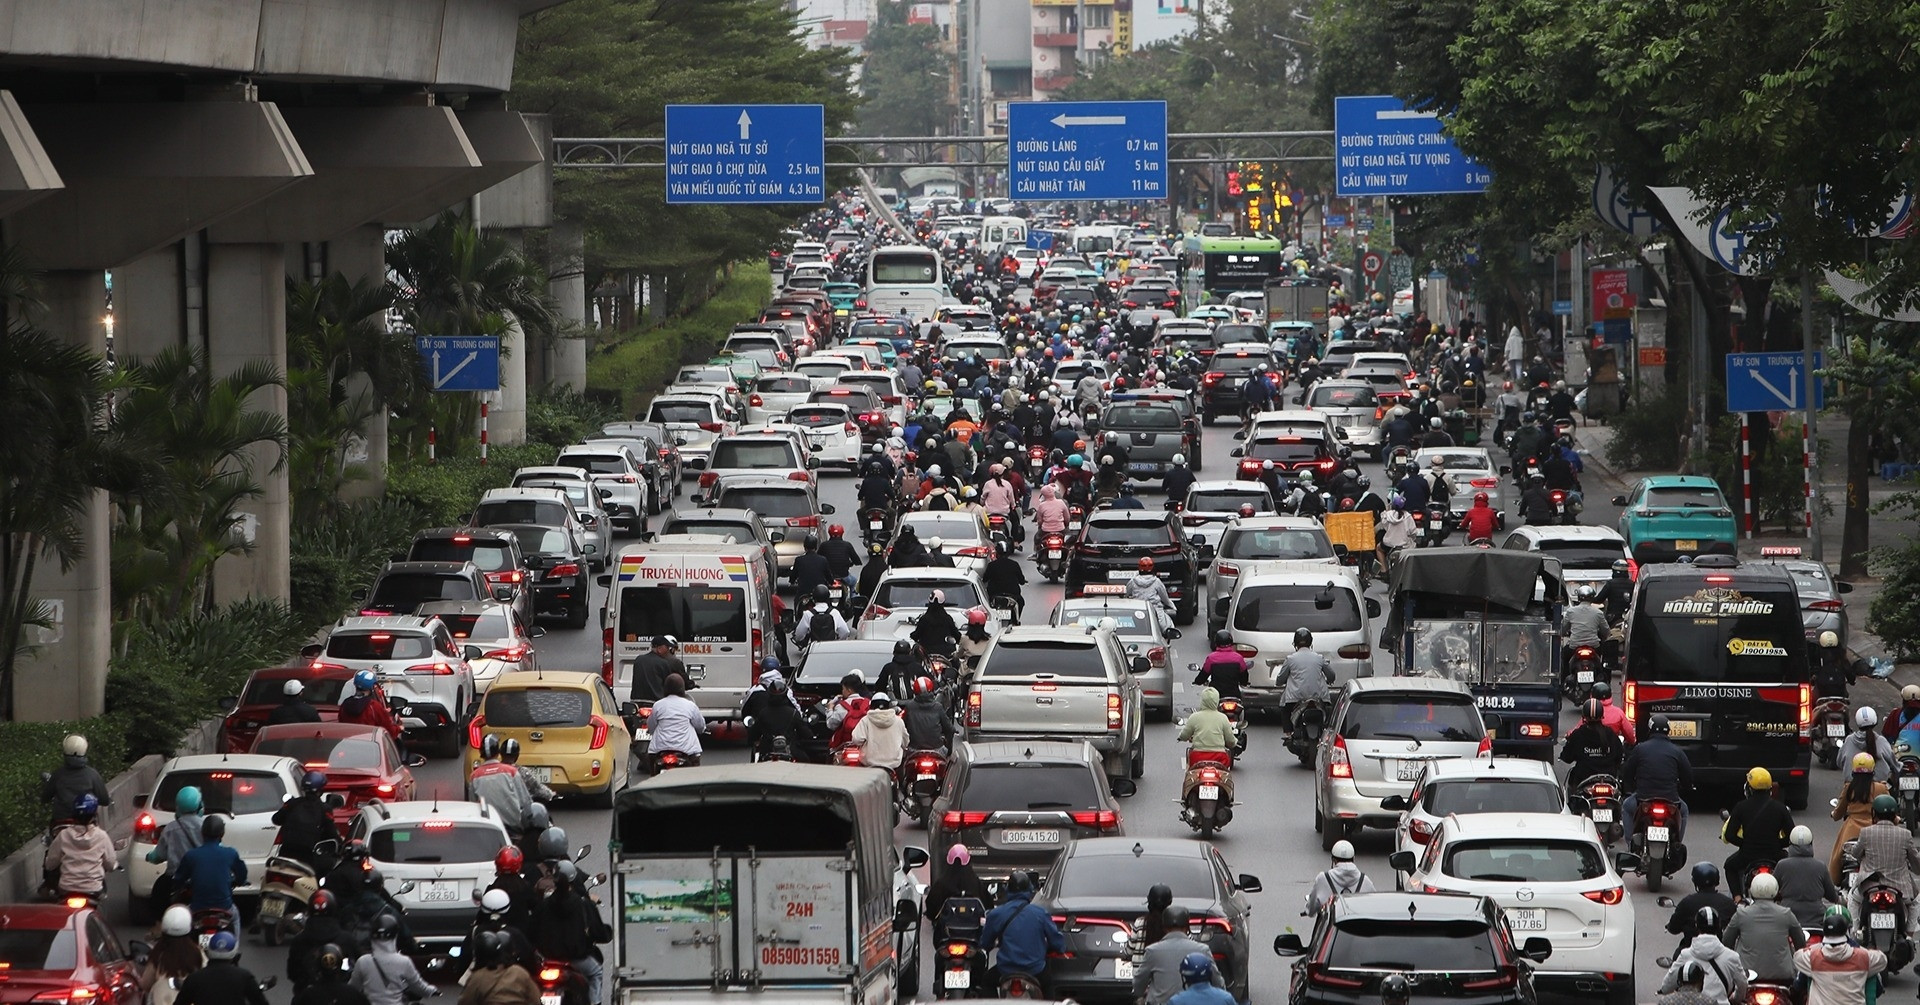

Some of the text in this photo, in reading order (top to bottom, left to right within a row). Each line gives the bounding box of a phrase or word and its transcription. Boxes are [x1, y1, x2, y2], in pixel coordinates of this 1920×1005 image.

[1017, 137, 1158, 152] ĐƯỜNG LÁNG 0,7 km
[1341, 130, 1447, 147] ĐƯỜNG TRƯỜNG CHINH
[670, 139, 768, 155] NÚT GIAO NGÃ TƯ SỞ
[1017, 156, 1158, 172] NÚT GIAO CẦU GIẤY 5 km
[1342, 152, 1360, 167] NÚT
[1363, 155, 1385, 167] GIAO
[1387, 152, 1406, 166] NGÃ
[1409, 154, 1422, 165] TƯ
[1425, 153, 1450, 168] VỌNG
[670, 160, 820, 177] NÚT GIAO Ô CHỢ DỪA 2,5 km
[671, 179, 820, 195] VĂN MIẾU QUỐC TỬ GIÁM 4,3 km
[1017, 177, 1159, 194] CẦU NHẬT TÂN 11 km
[1342, 172, 1490, 187] CẦU VĨNH TUY 8 km
[453, 339, 477, 349] TRƯỜNG
[478, 340, 496, 349] CHINH
[1732, 356, 1744, 367] TÂY
[1767, 355, 1794, 366] TRƯỜNG
[685, 567, 724, 581] HƯƠNG
[1663, 599, 1774, 615] HOÀNG PHƯƠNG
[1685, 688, 1752, 698] LIMOUSINE
[1477, 696, 1515, 708] 840.84
[1746, 722, 1797, 731] 29G-013.06
[1404, 761, 1419, 770] 29A
[1008, 830, 1058, 842] 30G-415.20
[424, 891, 455, 901] 282.60
[786, 902, 814, 917] 24H
[1517, 911, 1534, 919] 30H
[1509, 920, 1542, 929] 017.86
[761, 947, 840, 965] 0859031559
